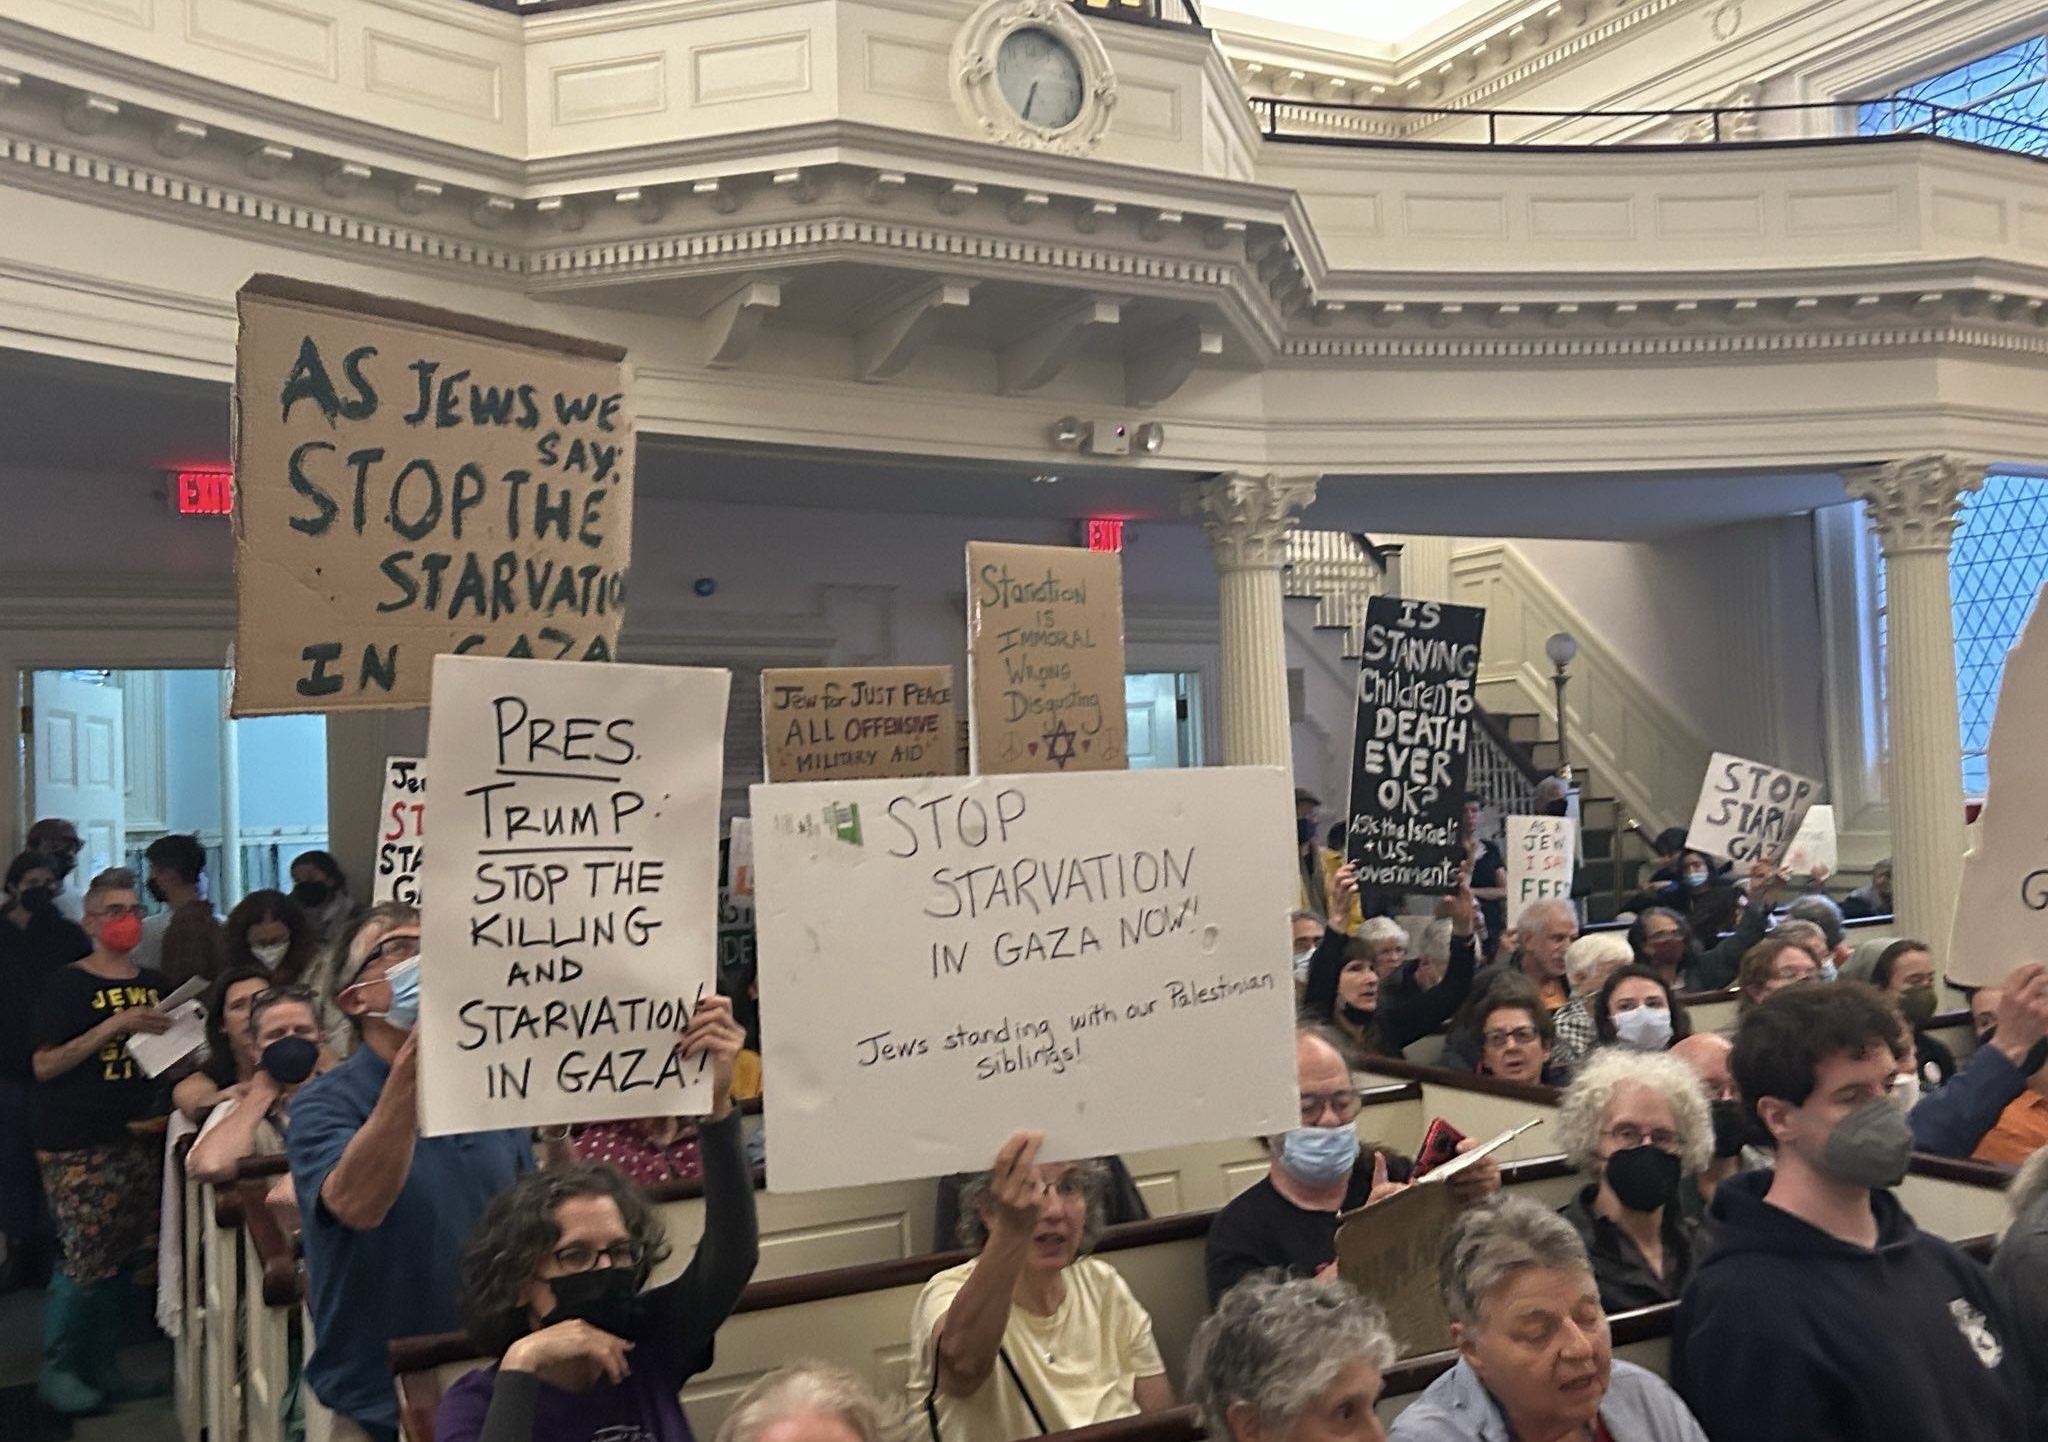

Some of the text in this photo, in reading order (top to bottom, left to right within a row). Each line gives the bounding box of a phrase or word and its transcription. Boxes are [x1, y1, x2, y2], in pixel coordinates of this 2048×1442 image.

[280, 335, 624, 432] AS JEWS WE
[288, 441, 606, 549] STOP THE
[1397, 601, 1441, 629] IS
[997, 628, 1096, 654] IMMORAL
[296, 642, 399, 696] IN
[1360, 667, 1447, 715] Children
[850, 681, 897, 707] JUST
[903, 683, 951, 707] PEACE
[493, 696, 642, 765] PRES.
[785, 714, 939, 747] ALL OFFENSIVE
[890, 745, 924, 763] AID
[1375, 708, 1467, 754] DEATH
[1364, 740, 1451, 788] EVER
[1714, 762, 1811, 810] STOP
[1378, 779, 1439, 817] OK?
[886, 789, 1026, 857] STOP
[472, 861, 664, 904] STOP THE
[923, 847, 1195, 919] STARVATION
[470, 906, 662, 949] KILLING
[507, 959, 583, 987] AND
[931, 941, 970, 979] IN
[994, 927, 1101, 967] GAZA
[856, 971, 1275, 1067] Jews standing with our Palestinian
[487, 1057, 532, 1099] IN
